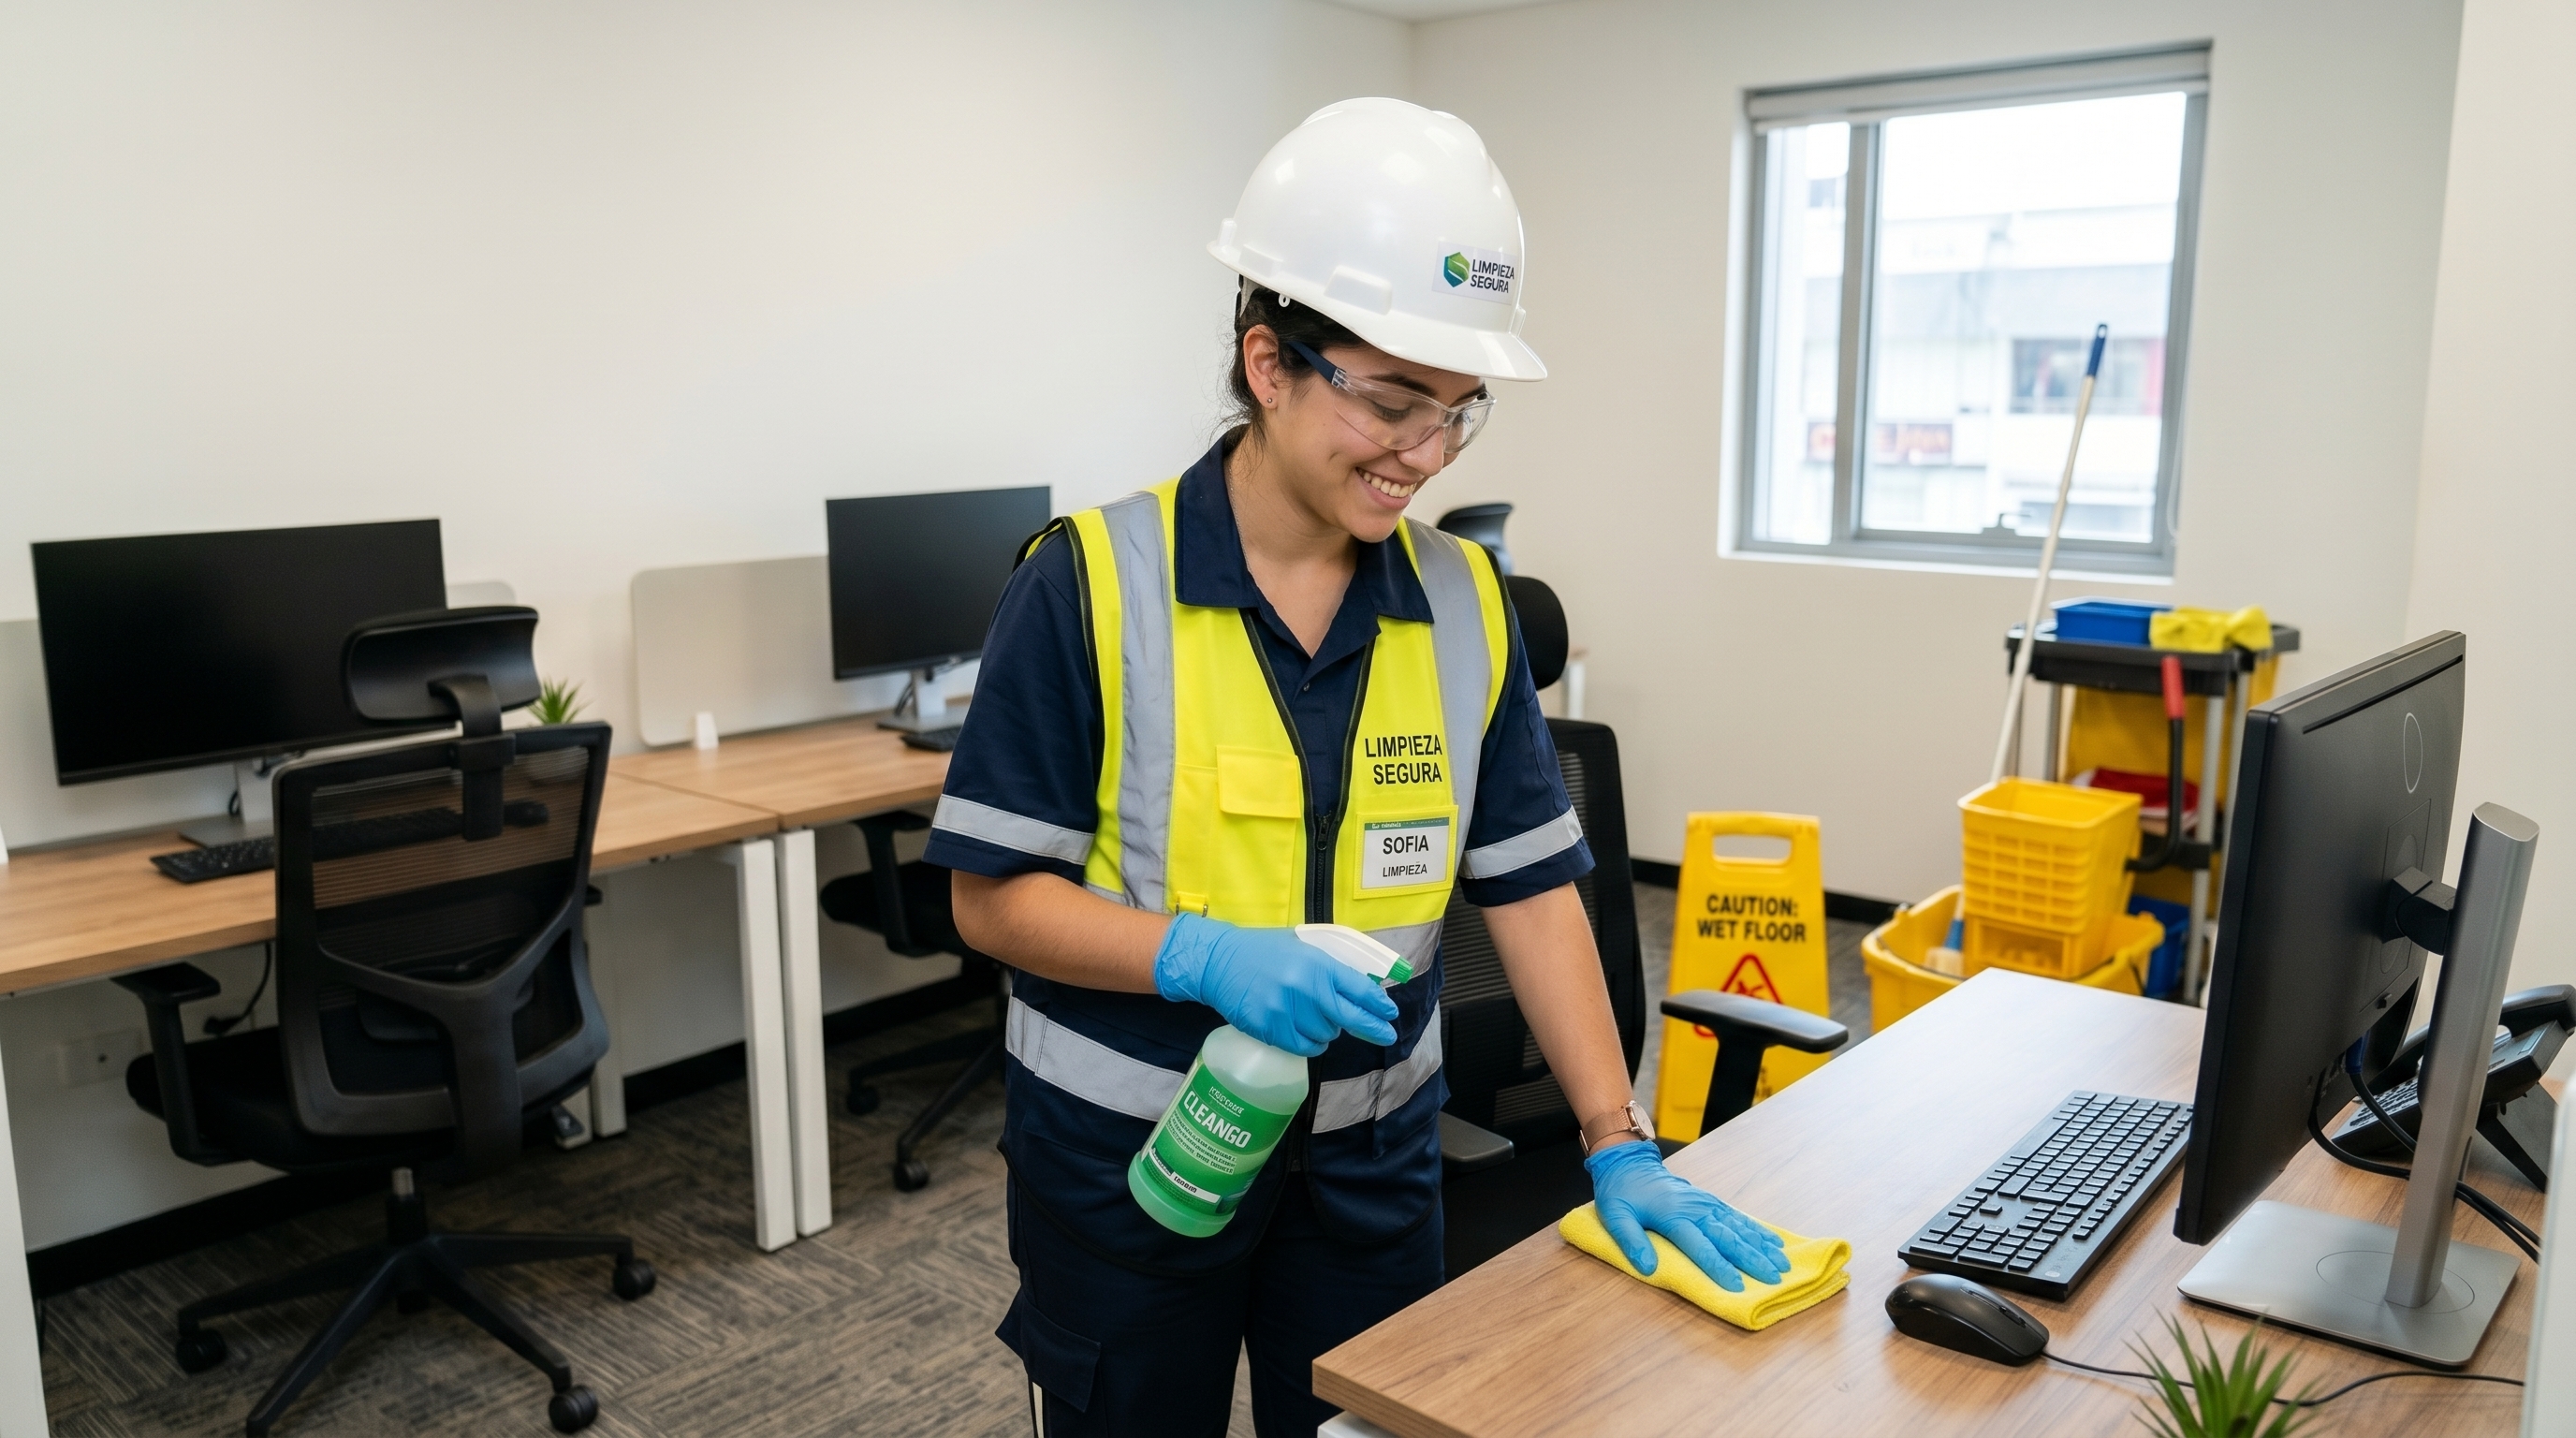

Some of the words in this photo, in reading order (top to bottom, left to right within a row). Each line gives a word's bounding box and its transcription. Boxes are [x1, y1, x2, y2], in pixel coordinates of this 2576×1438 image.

[1471, 259, 1515, 279] LIMPIEZA
[1471, 274, 1509, 293] SEGURA
[1365, 735, 1442, 757] LIMPIEZA
[1373, 762, 1442, 785] SEGURA
[1383, 835, 1428, 855] SOFIA
[1383, 863, 1427, 877] LIMPIEZA
[1706, 894, 1798, 917] CAUTION:
[1697, 919, 1738, 941] WET
[1744, 920, 1806, 942] FLOOR
[1183, 1091, 1251, 1149] CLEANGO
